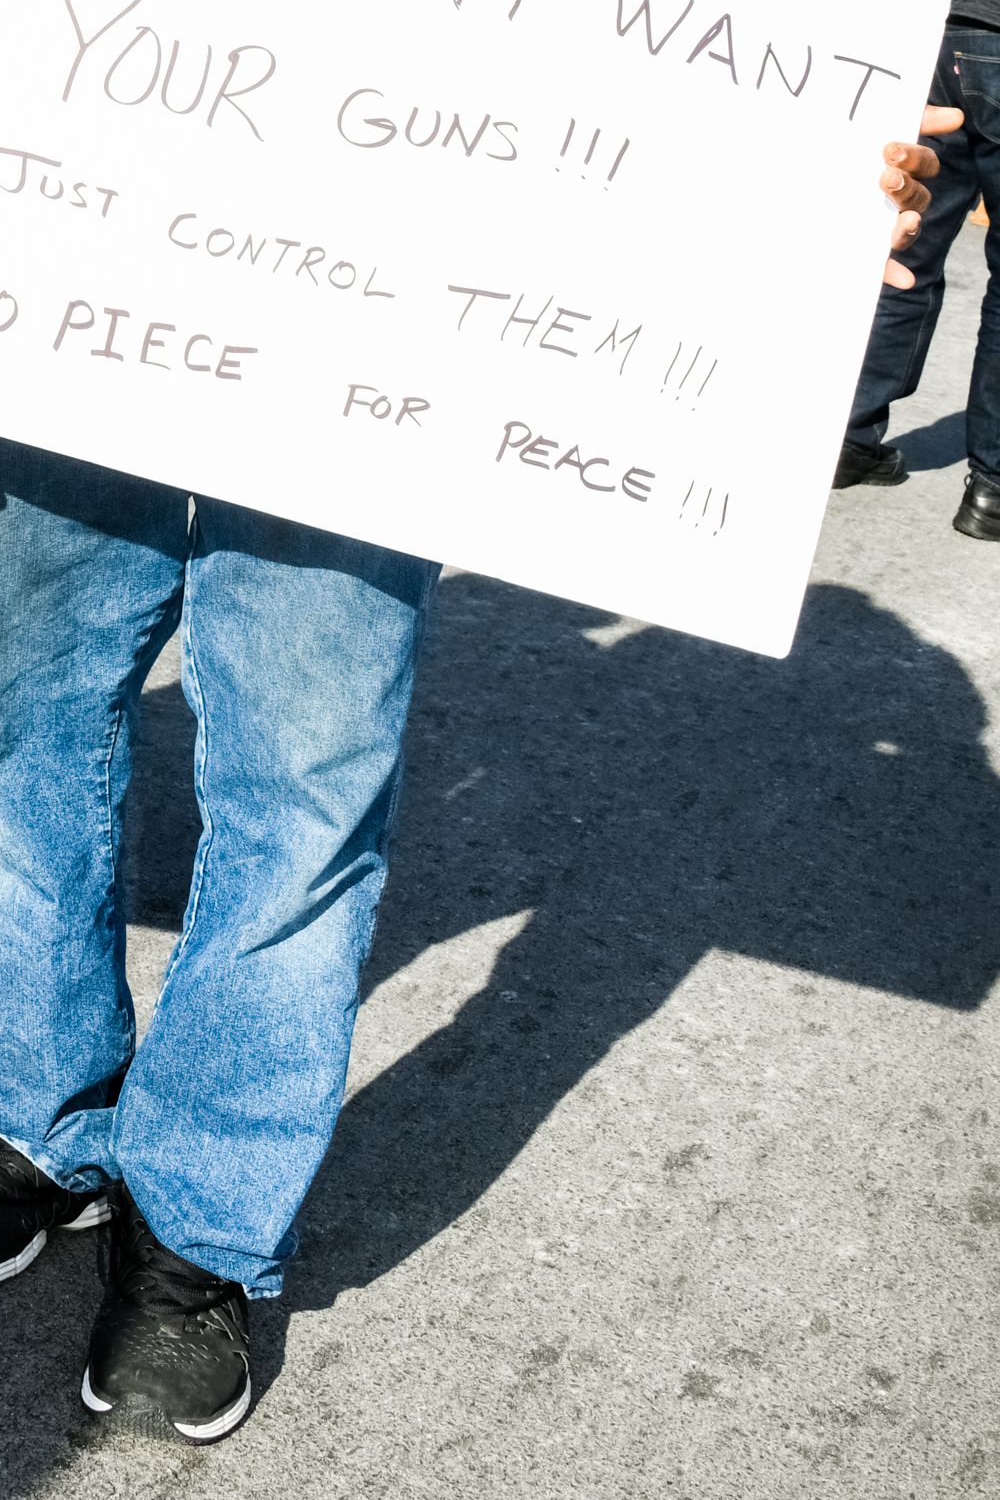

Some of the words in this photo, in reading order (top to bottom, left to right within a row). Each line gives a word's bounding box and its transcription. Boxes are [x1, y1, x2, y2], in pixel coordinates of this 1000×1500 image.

[168, 213, 395, 299] CONTROL
[53, 300, 258, 380] PIECE
[343, 384, 431, 427] FOR
